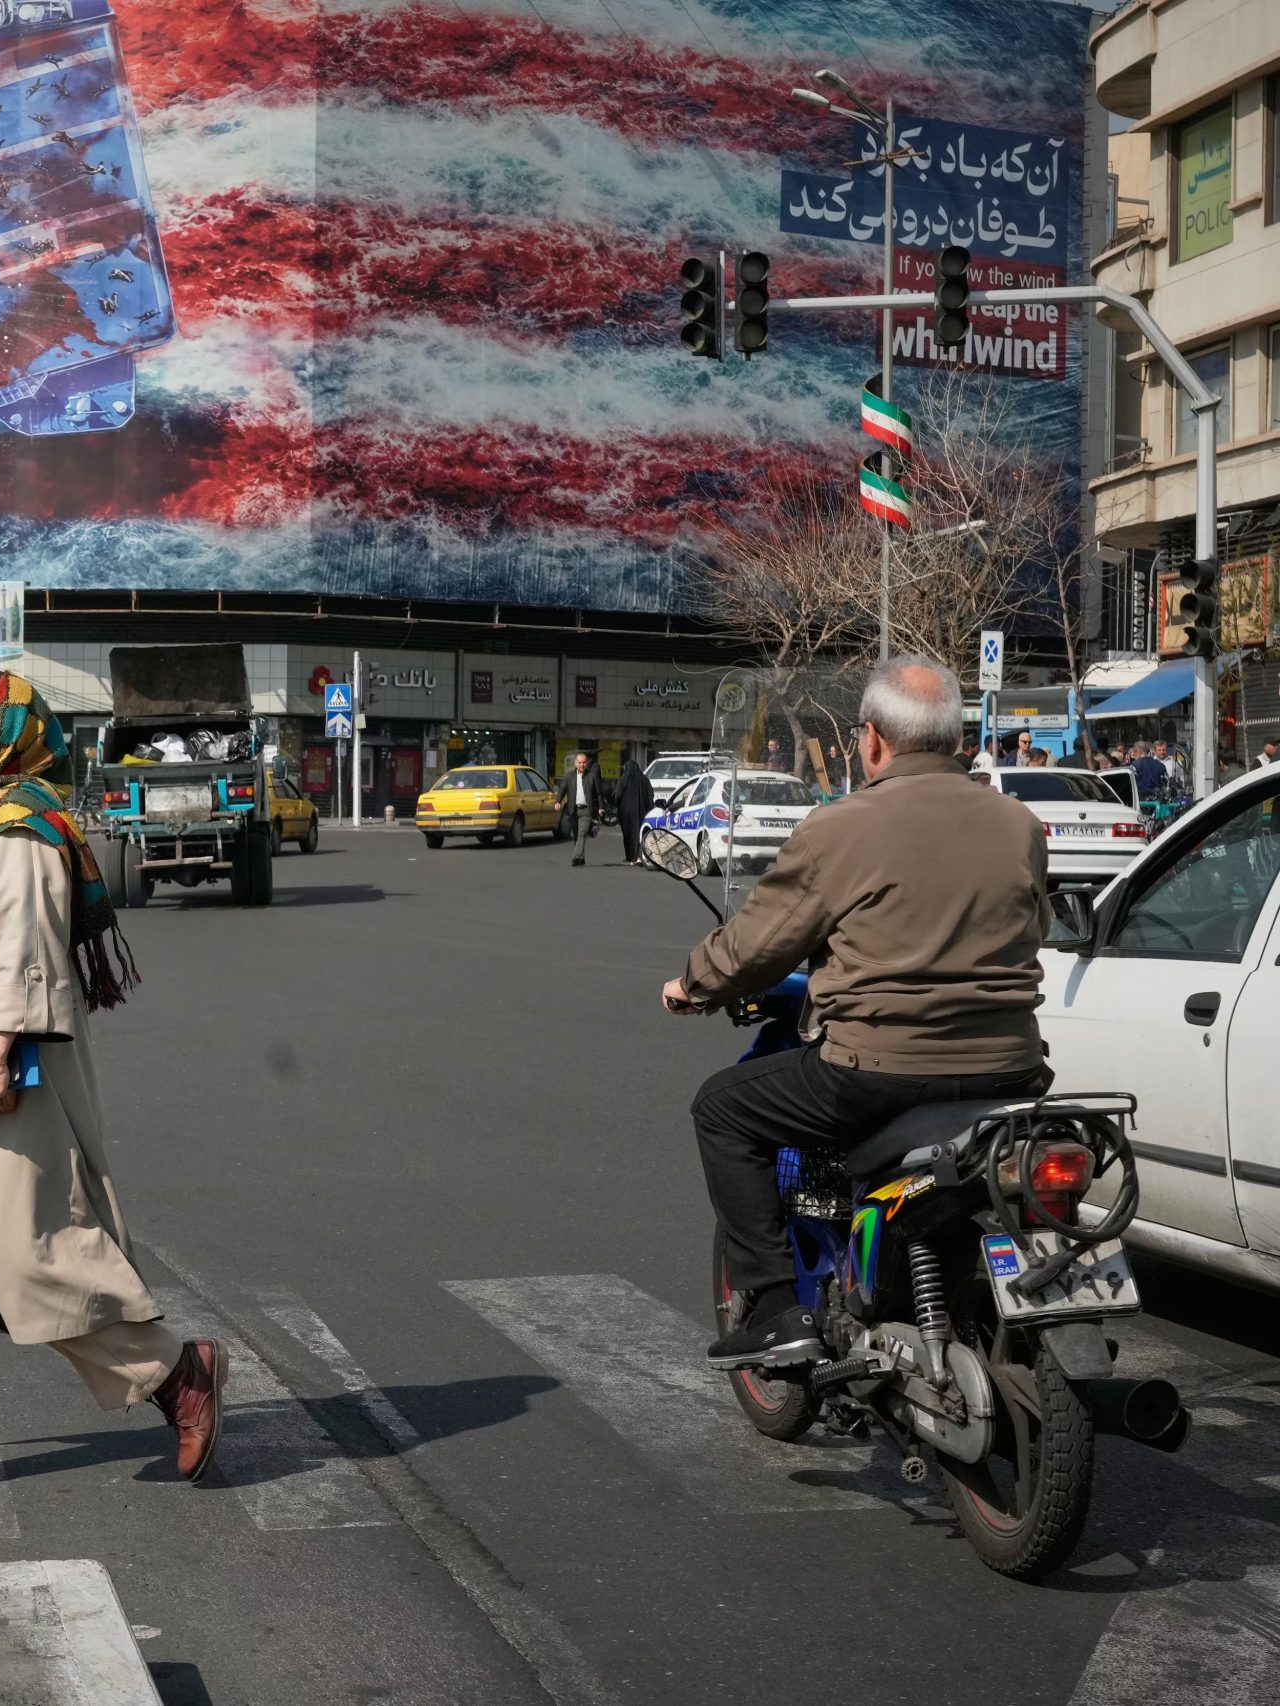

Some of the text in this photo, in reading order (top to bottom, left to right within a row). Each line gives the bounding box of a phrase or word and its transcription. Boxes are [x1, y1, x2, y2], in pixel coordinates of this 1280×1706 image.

[861, 126, 1065, 196] آن که باد بکرد
[949, 197, 1057, 257] طوفان
[899, 255, 911, 275] If
[915, 261, 935, 281] yo
[988, 266, 1014, 287] the
[1019, 271, 1056, 290] wind
[1024, 303, 1059, 325] the
[1133, 570, 1146, 650] SAMSUNG
[394, 669, 437, 695] بانک
[636, 678, 689, 697] کفش ملی
[510, 688, 551, 703] ساعتی
[992, 1258, 1008, 1267] I.R.
[994, 1265, 1019, 1276] IRAN
